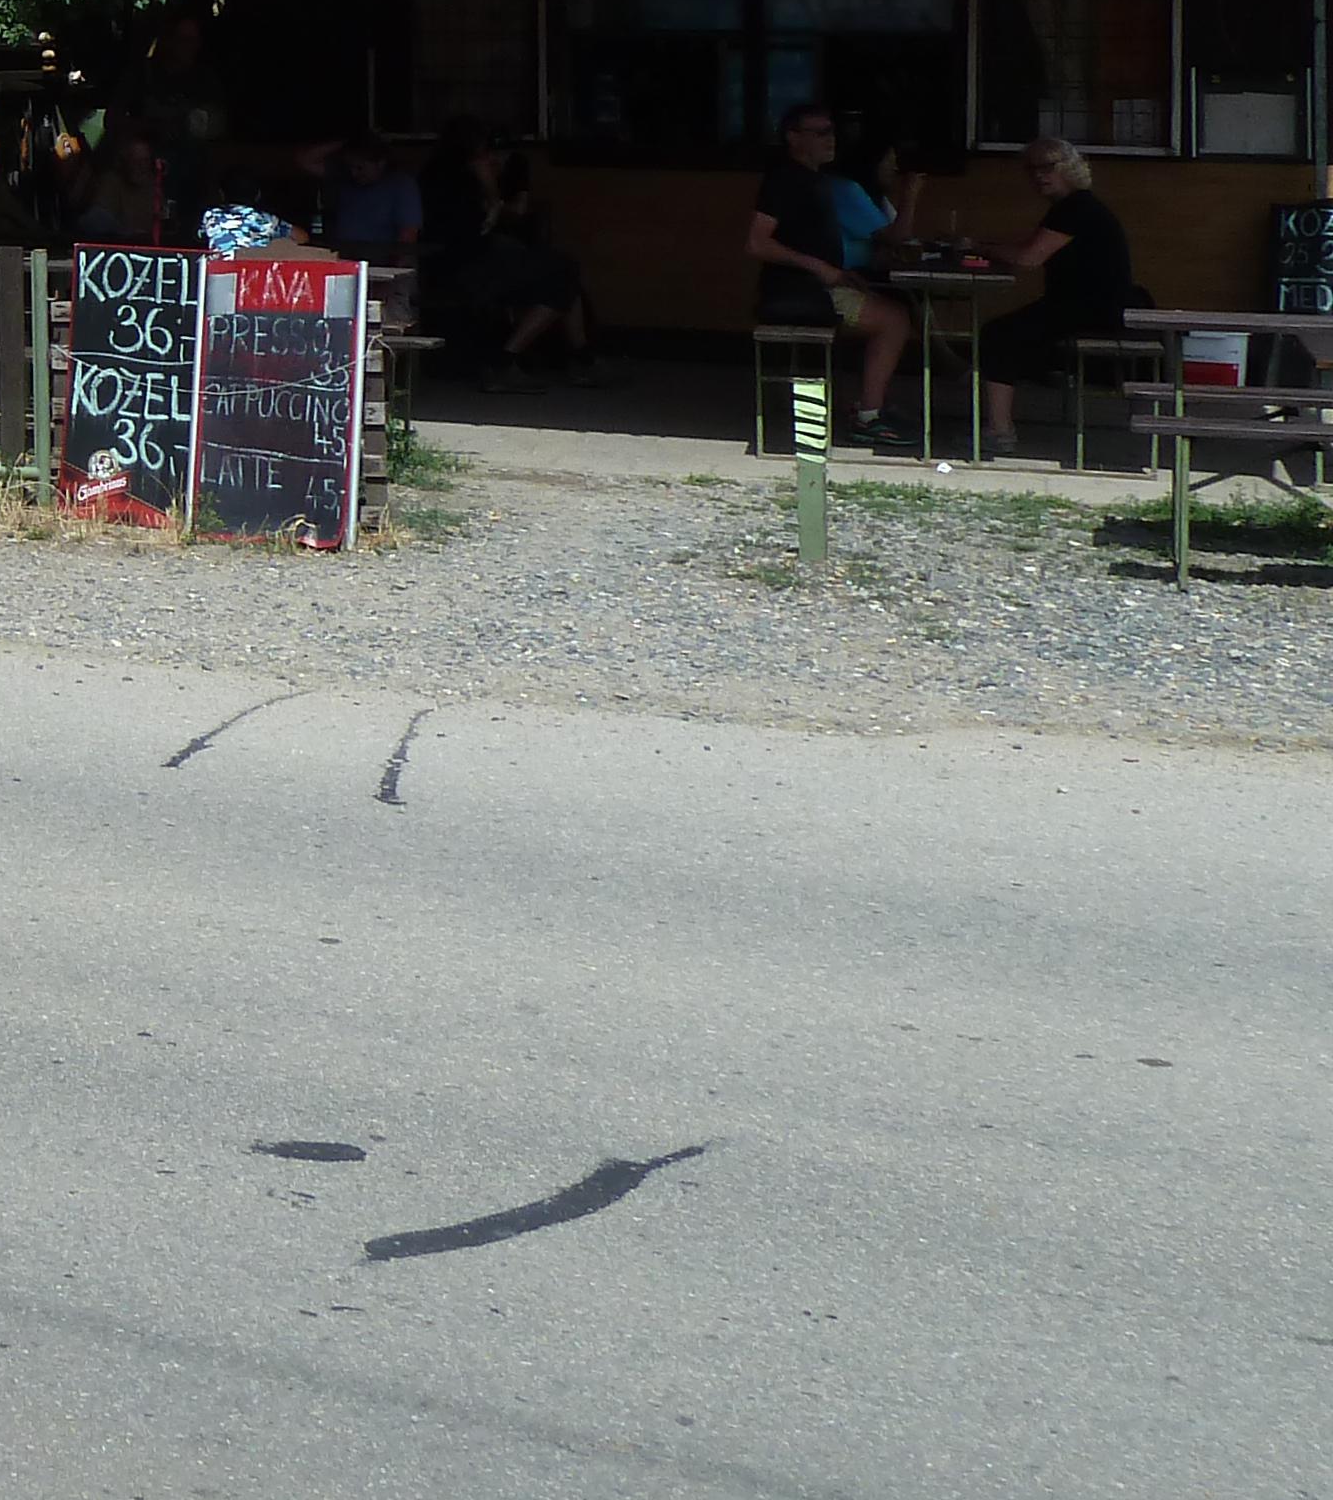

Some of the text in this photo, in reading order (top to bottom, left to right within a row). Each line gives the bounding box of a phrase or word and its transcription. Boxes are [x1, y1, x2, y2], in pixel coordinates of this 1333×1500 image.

[78, 251, 198, 306] KOZEL
[237, 261, 315, 307] KÁVA
[208, 314, 331, 356] PRESSO
[71, 360, 191, 421] KOZEL
[200, 451, 283, 491] LATTE
